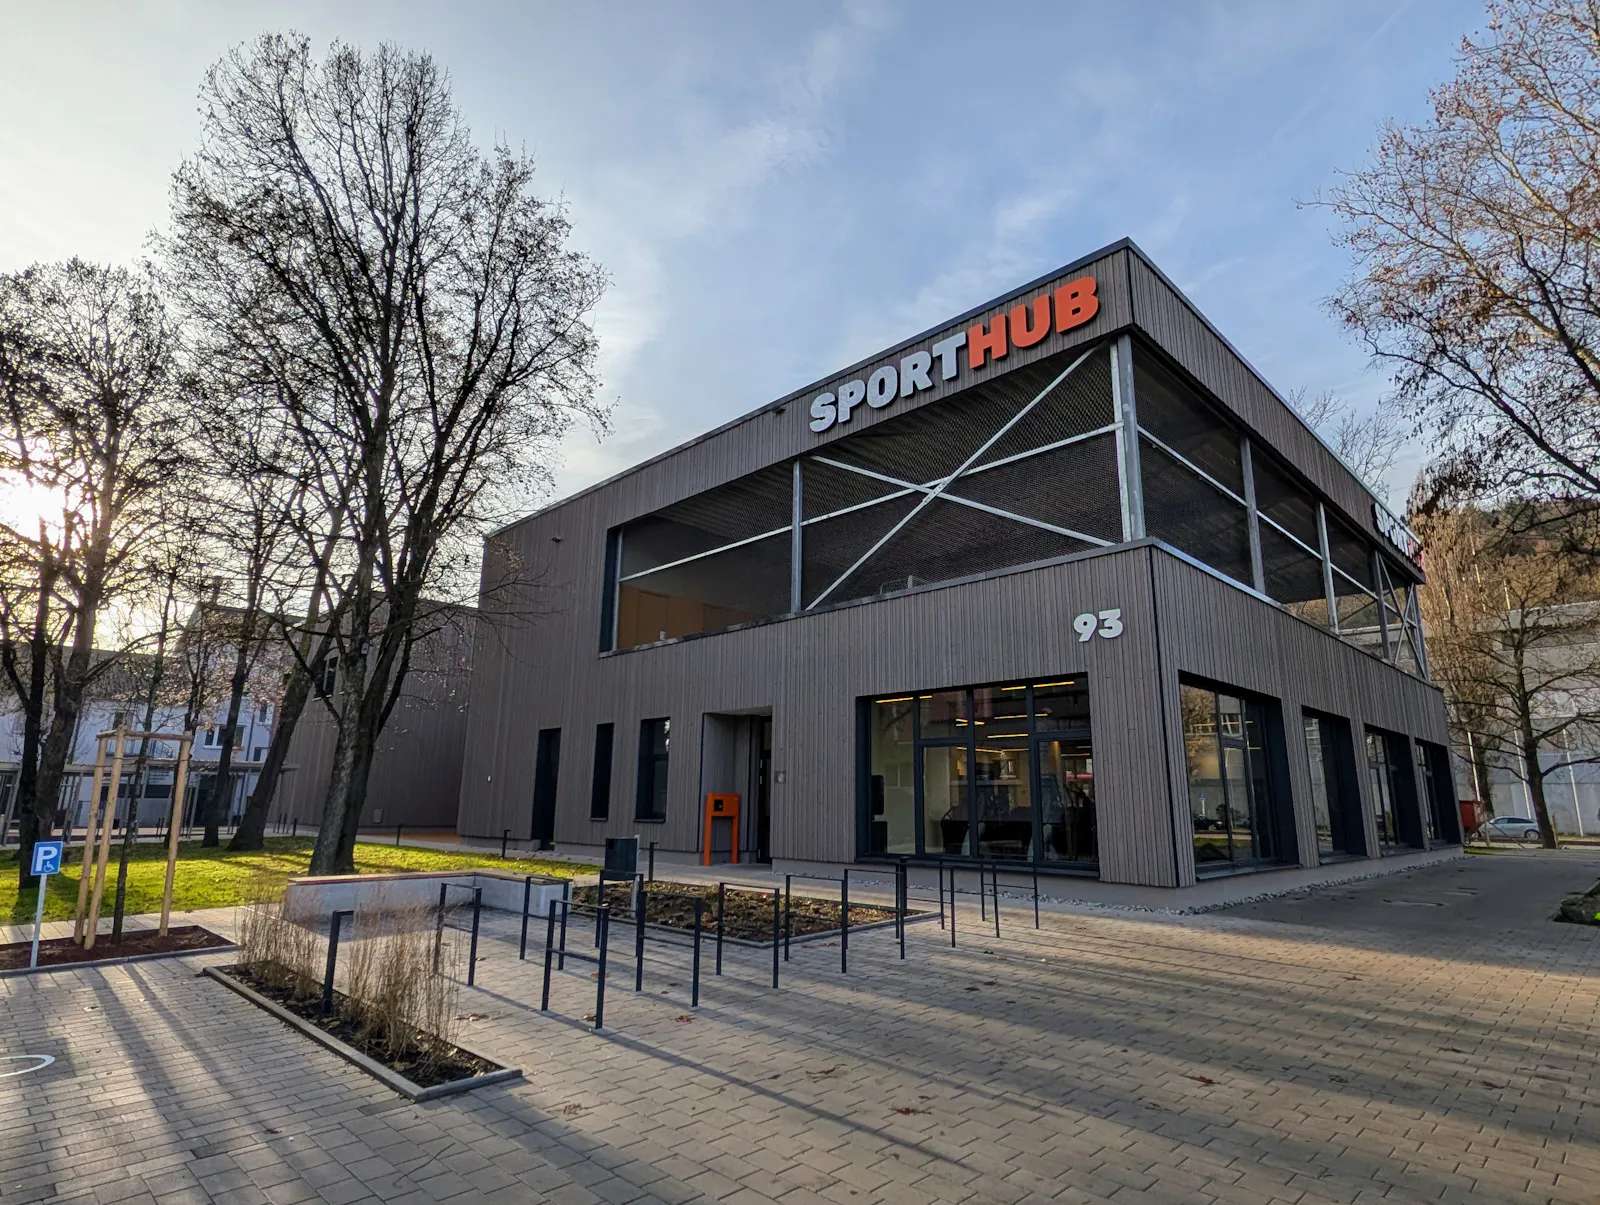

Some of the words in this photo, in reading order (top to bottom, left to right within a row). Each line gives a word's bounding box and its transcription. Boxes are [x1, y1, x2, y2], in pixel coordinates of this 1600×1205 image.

[809, 276, 1099, 432] SPORTHUB
[1073, 608, 1123, 642] 93
[35, 846, 58, 872] P
